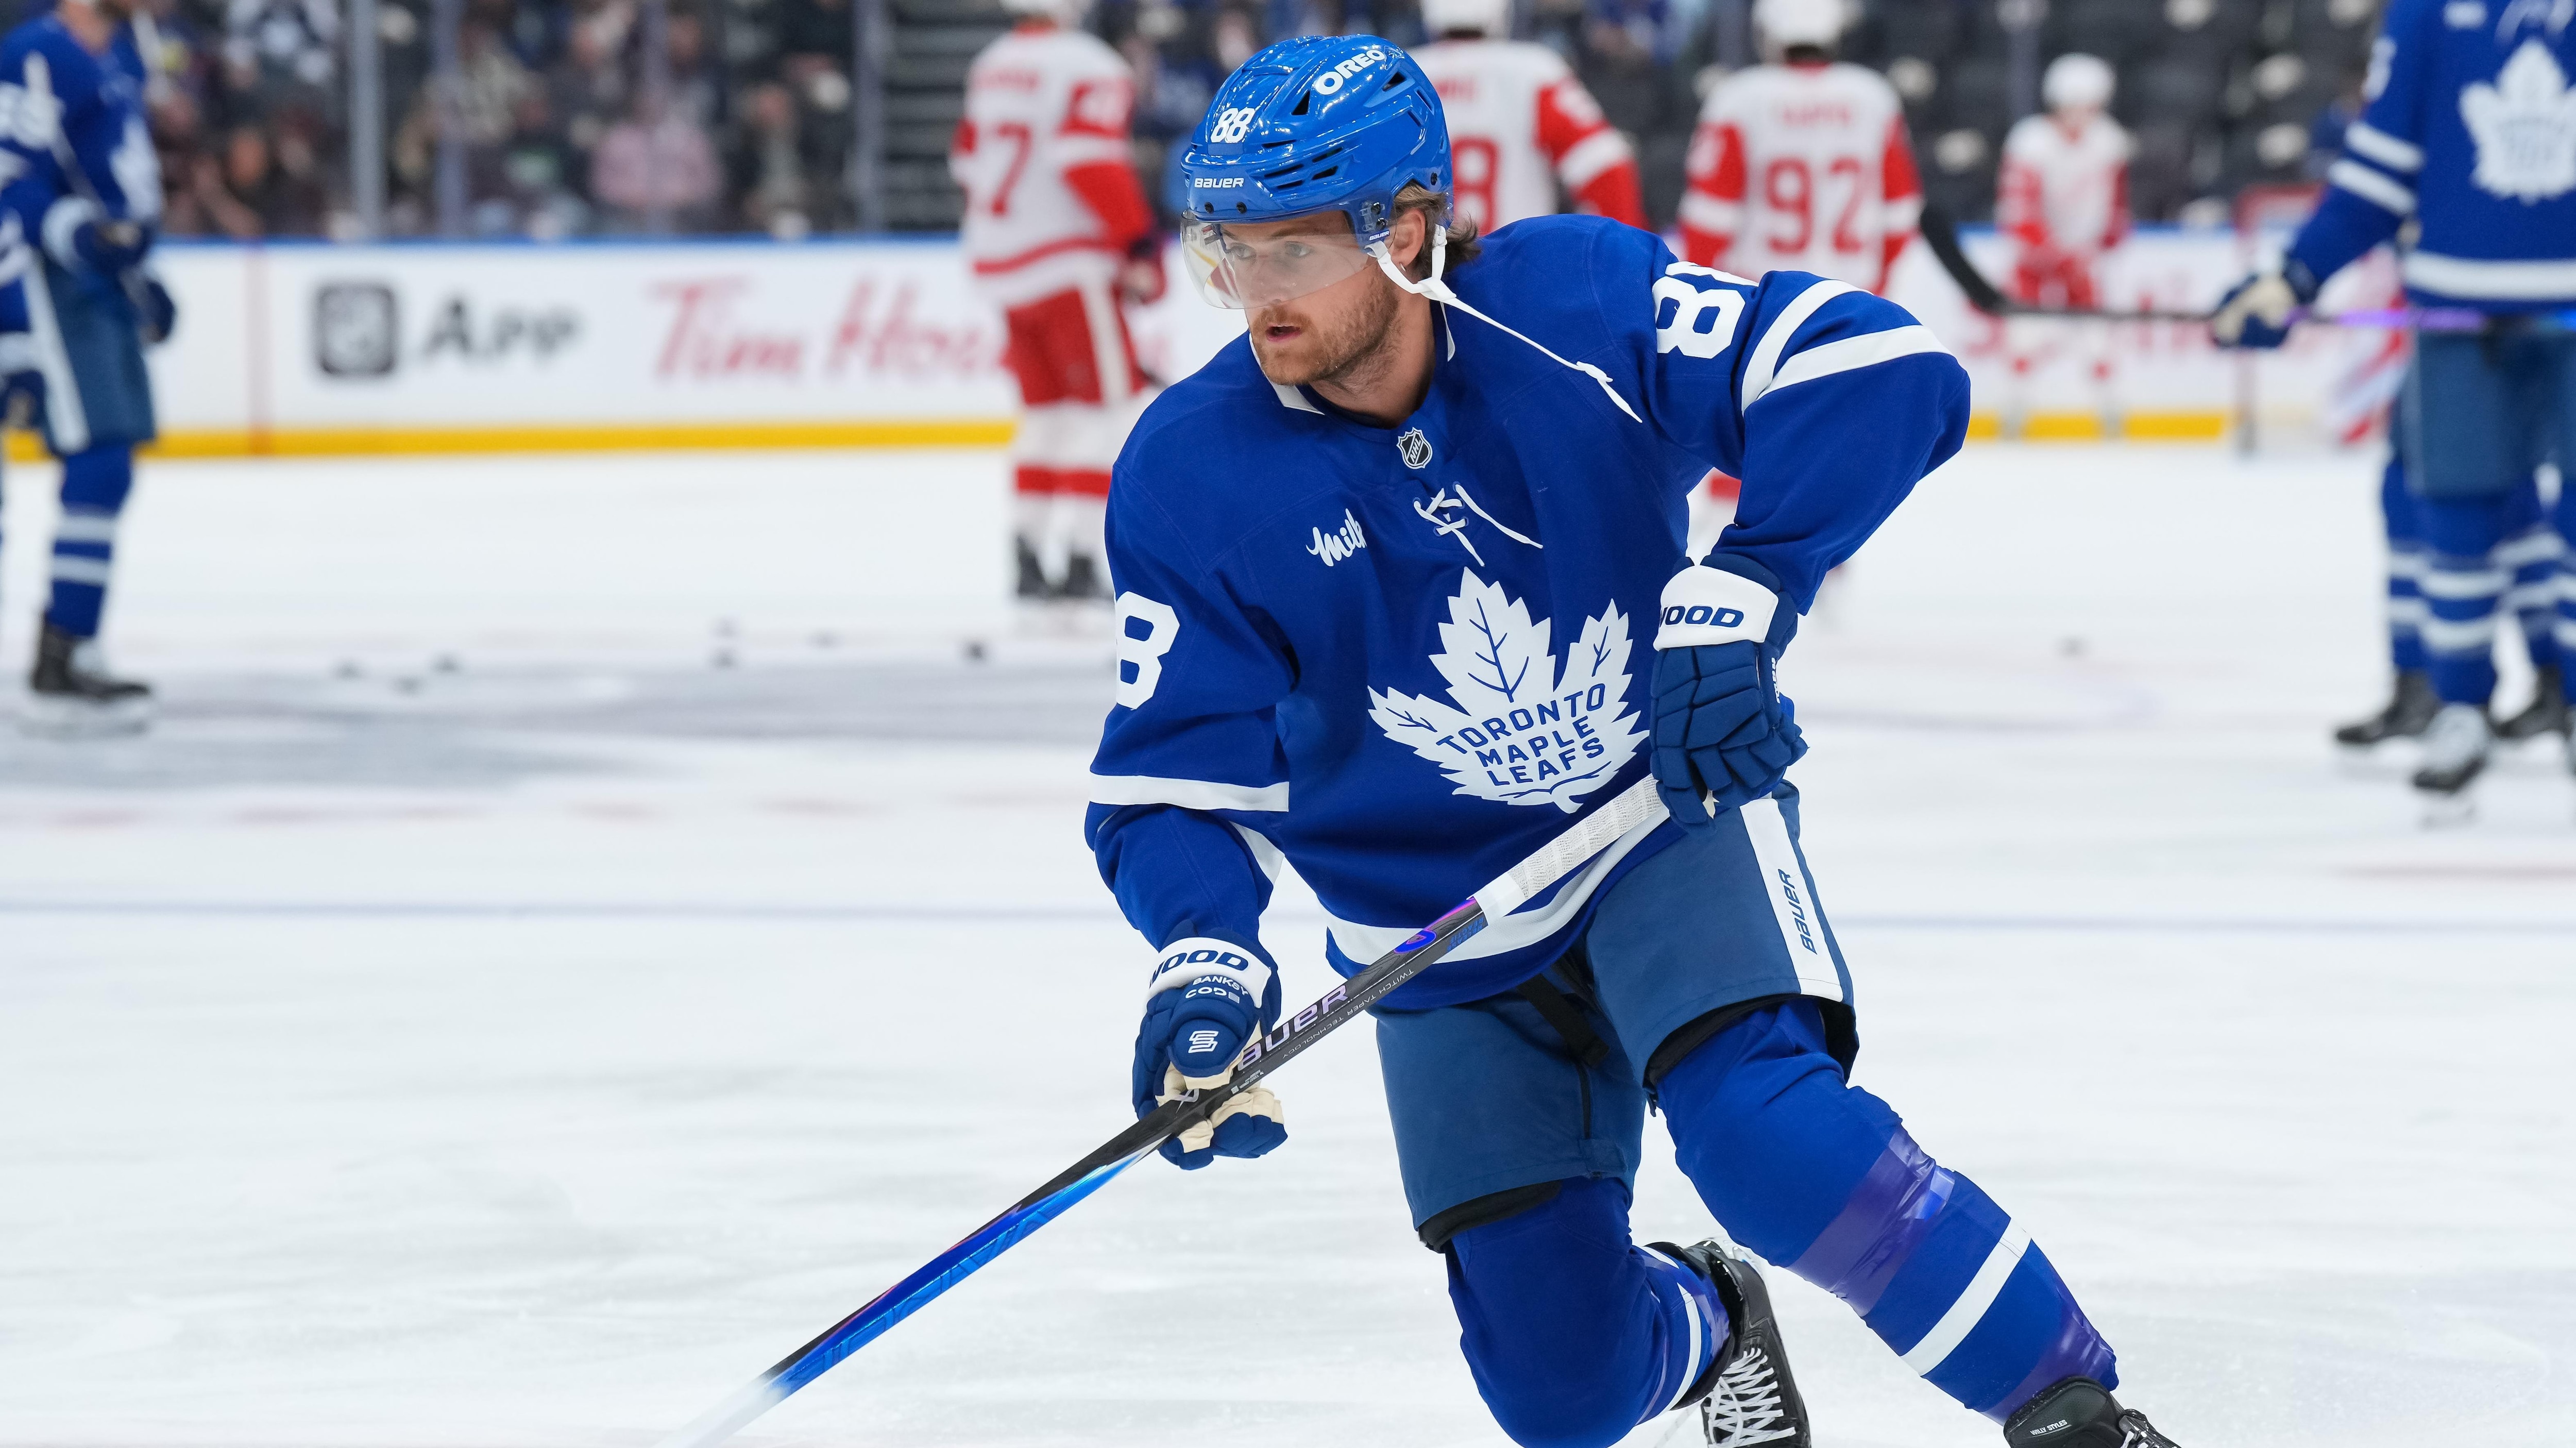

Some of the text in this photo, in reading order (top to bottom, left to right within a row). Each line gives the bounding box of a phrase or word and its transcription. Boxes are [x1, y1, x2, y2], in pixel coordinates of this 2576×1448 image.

[1313, 49, 1387, 95] OREO
[1211, 107, 1256, 143] 88
[1763, 156, 1866, 256] 92
[1410, 438, 1421, 463] NHL
[1436, 683, 1605, 754] TORONTO
[1475, 716, 1595, 768] MAPLE
[1487, 737, 1605, 786] LEAFS
[1238, 985, 1348, 1071] AUER
[1282, 969, 1415, 1059] TWITCH TAPER TECHNOLOGY
[2030, 1419, 2067, 1435] WILLY STYLES
